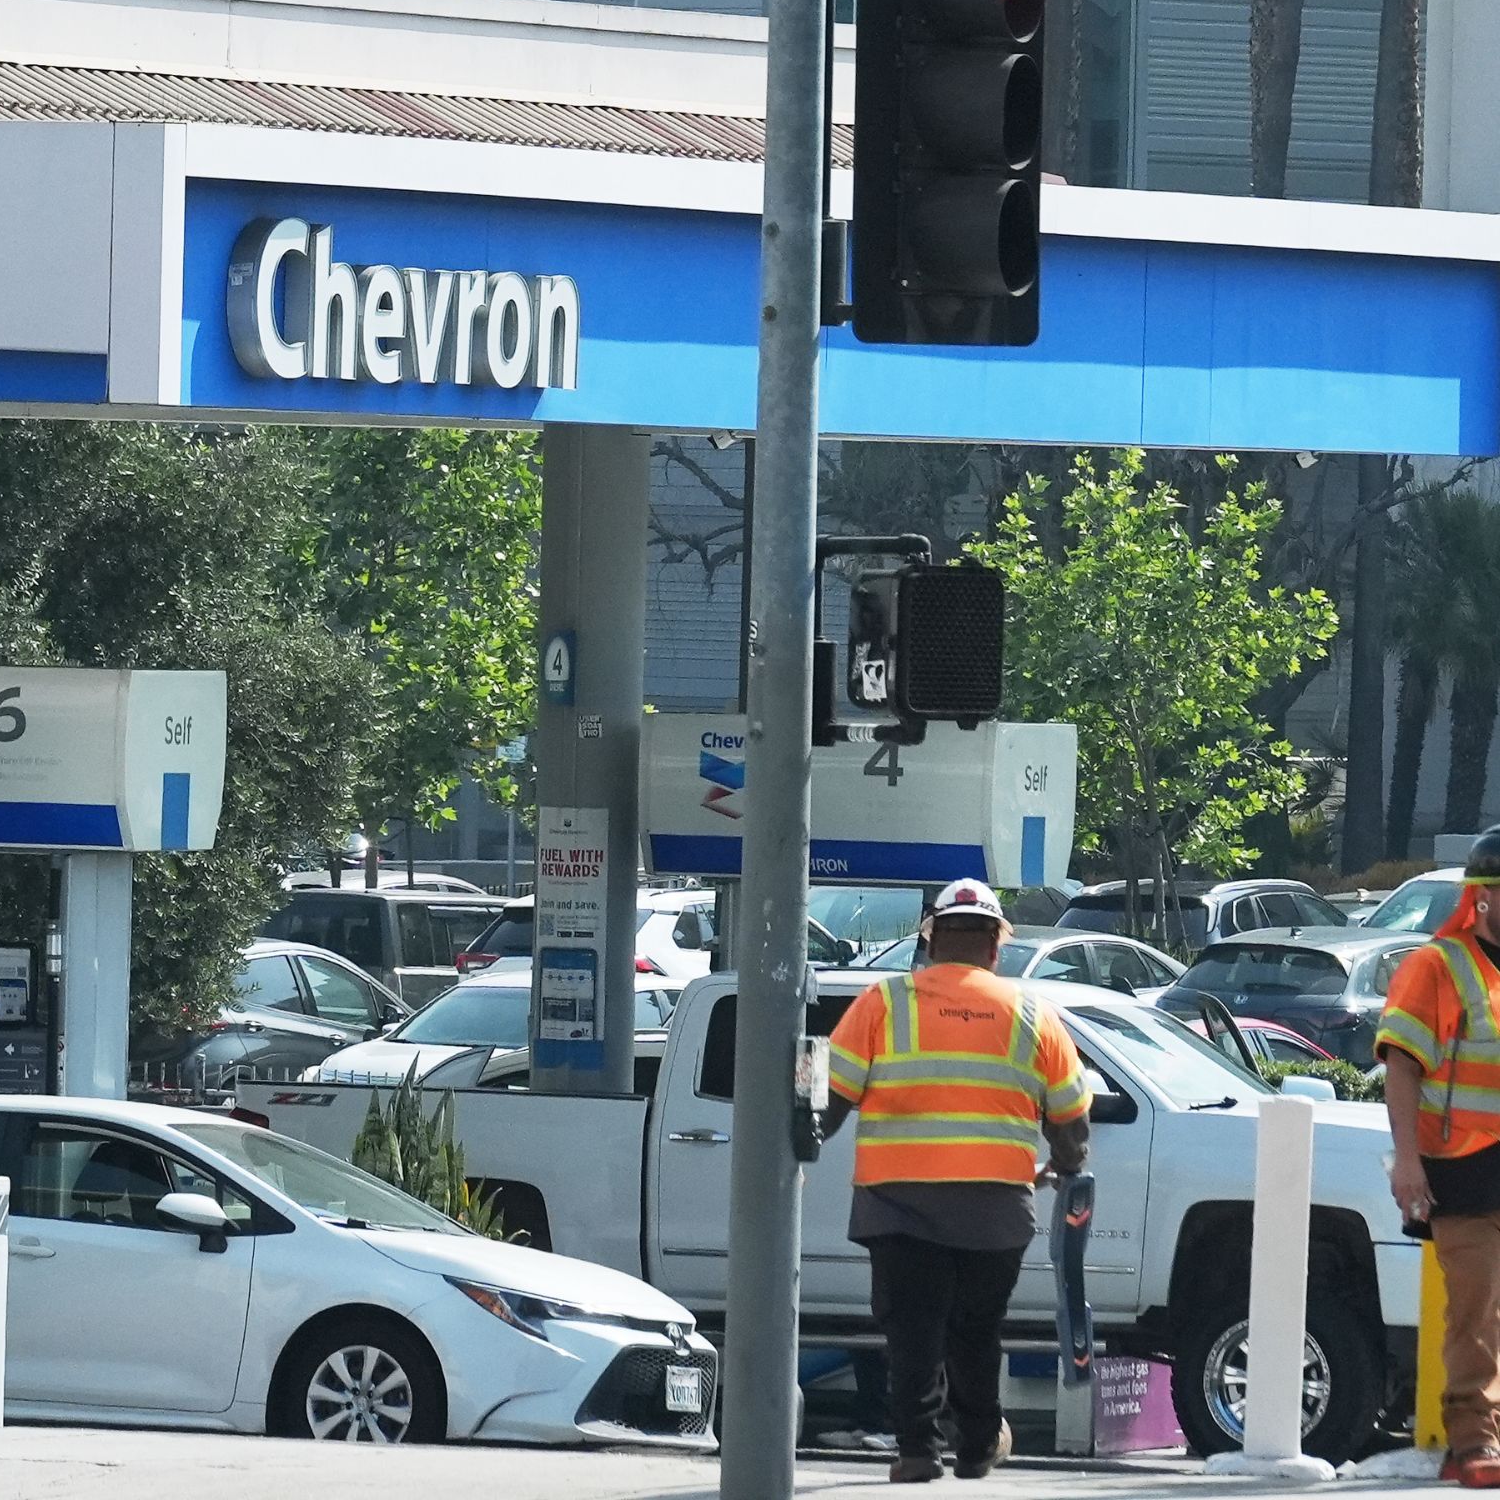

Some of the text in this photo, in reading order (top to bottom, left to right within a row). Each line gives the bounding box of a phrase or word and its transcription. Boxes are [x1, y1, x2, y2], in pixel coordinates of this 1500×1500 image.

[245, 217, 580, 390] Chevron
[553, 648, 563, 676] 4
[165, 716, 193, 746] Self
[864, 741, 903, 787] 4
[1024, 764, 1048, 792] Self
[541, 848, 604, 863] FUEL WITH
[542, 864, 600, 877] REWARDS
